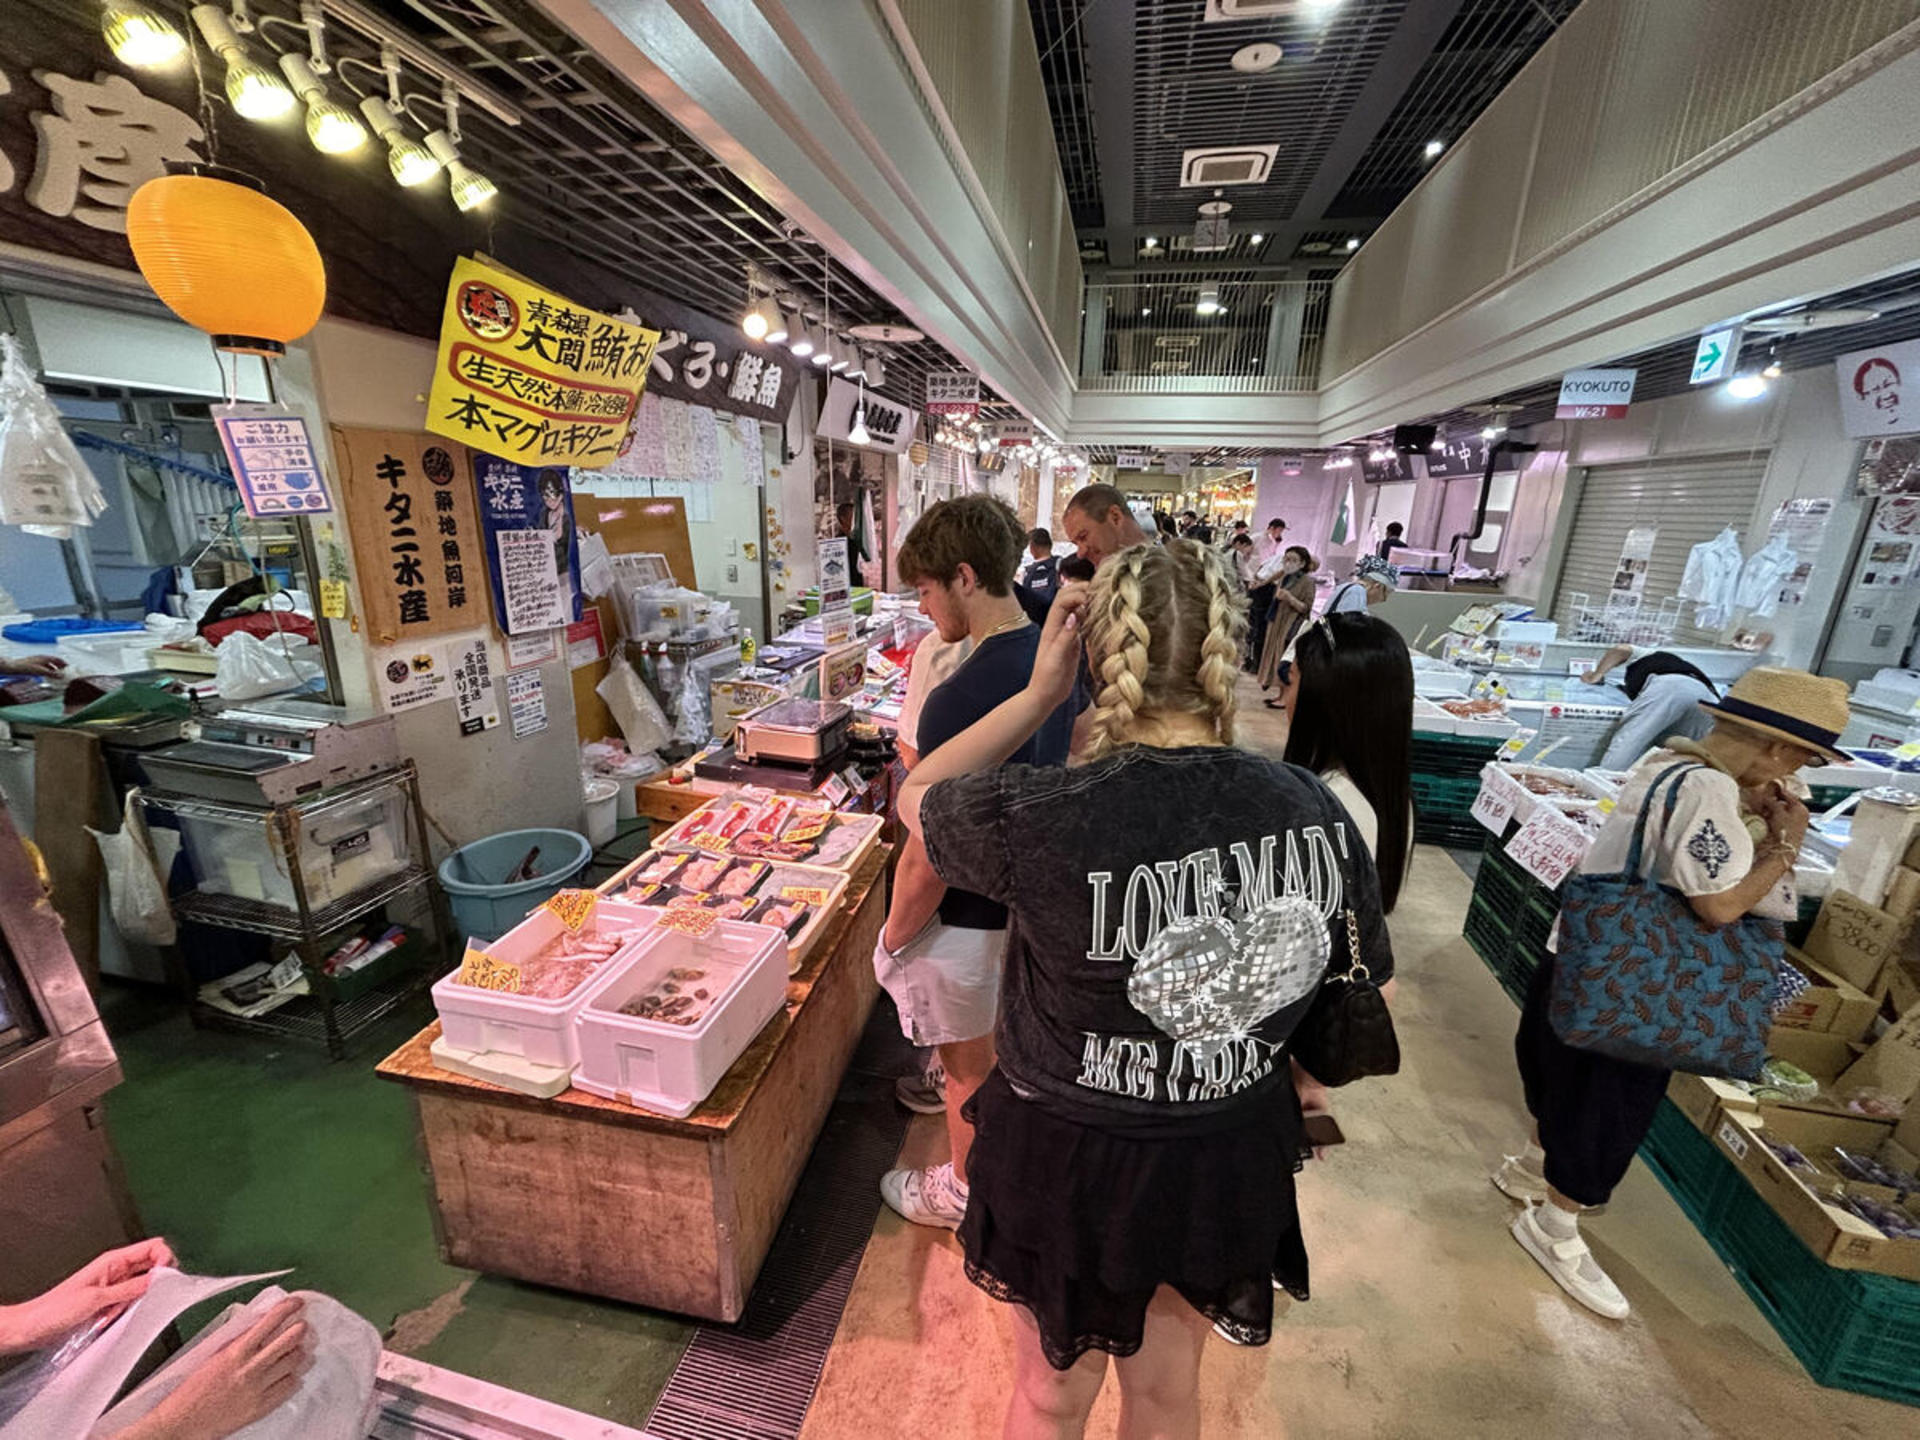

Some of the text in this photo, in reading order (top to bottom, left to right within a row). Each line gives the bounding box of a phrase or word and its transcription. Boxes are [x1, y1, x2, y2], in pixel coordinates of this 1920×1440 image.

[0, 68, 206, 235] 産
[527, 298, 590, 338] 青森県
[612, 307, 783, 408] ぐろ・鮮魚
[1563, 380, 1631, 393] KYOKUTO
[1575, 406, 1607, 417] W-21
[245, 423, 289, 434] ご協力
[376, 453, 430, 625] キタニ水産
[453, 668, 473, 718] 承ります
[464, 651, 482, 701] 全国発送
